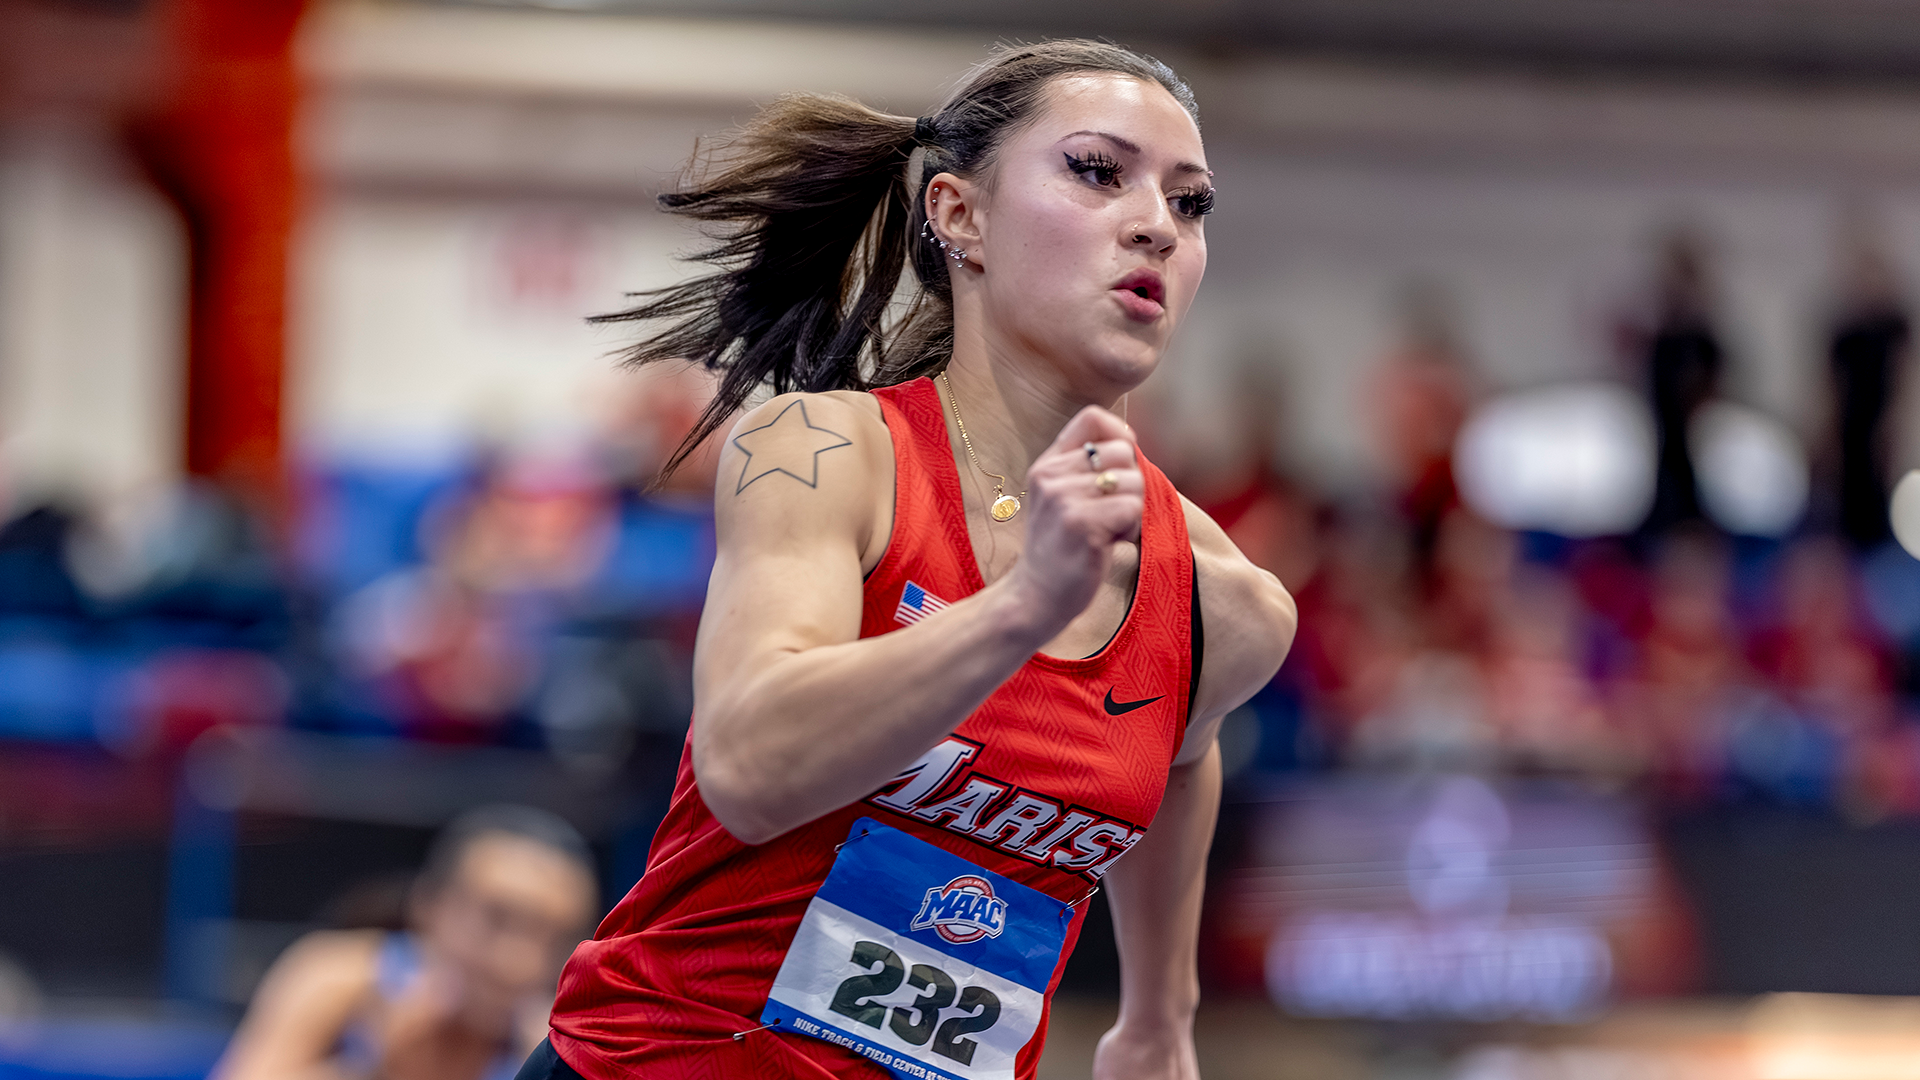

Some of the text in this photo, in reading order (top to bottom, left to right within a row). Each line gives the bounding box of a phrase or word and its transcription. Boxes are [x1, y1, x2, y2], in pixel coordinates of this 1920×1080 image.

[912, 887, 1006, 936] MAAC
[829, 940, 1001, 1067] 232
[793, 1017, 821, 1036] NIKE
[821, 1029, 856, 1049] TRACK
[854, 1043, 864, 1053] &
[863, 1046, 893, 1065] FIELD
[892, 1058, 926, 1079] CENTER
